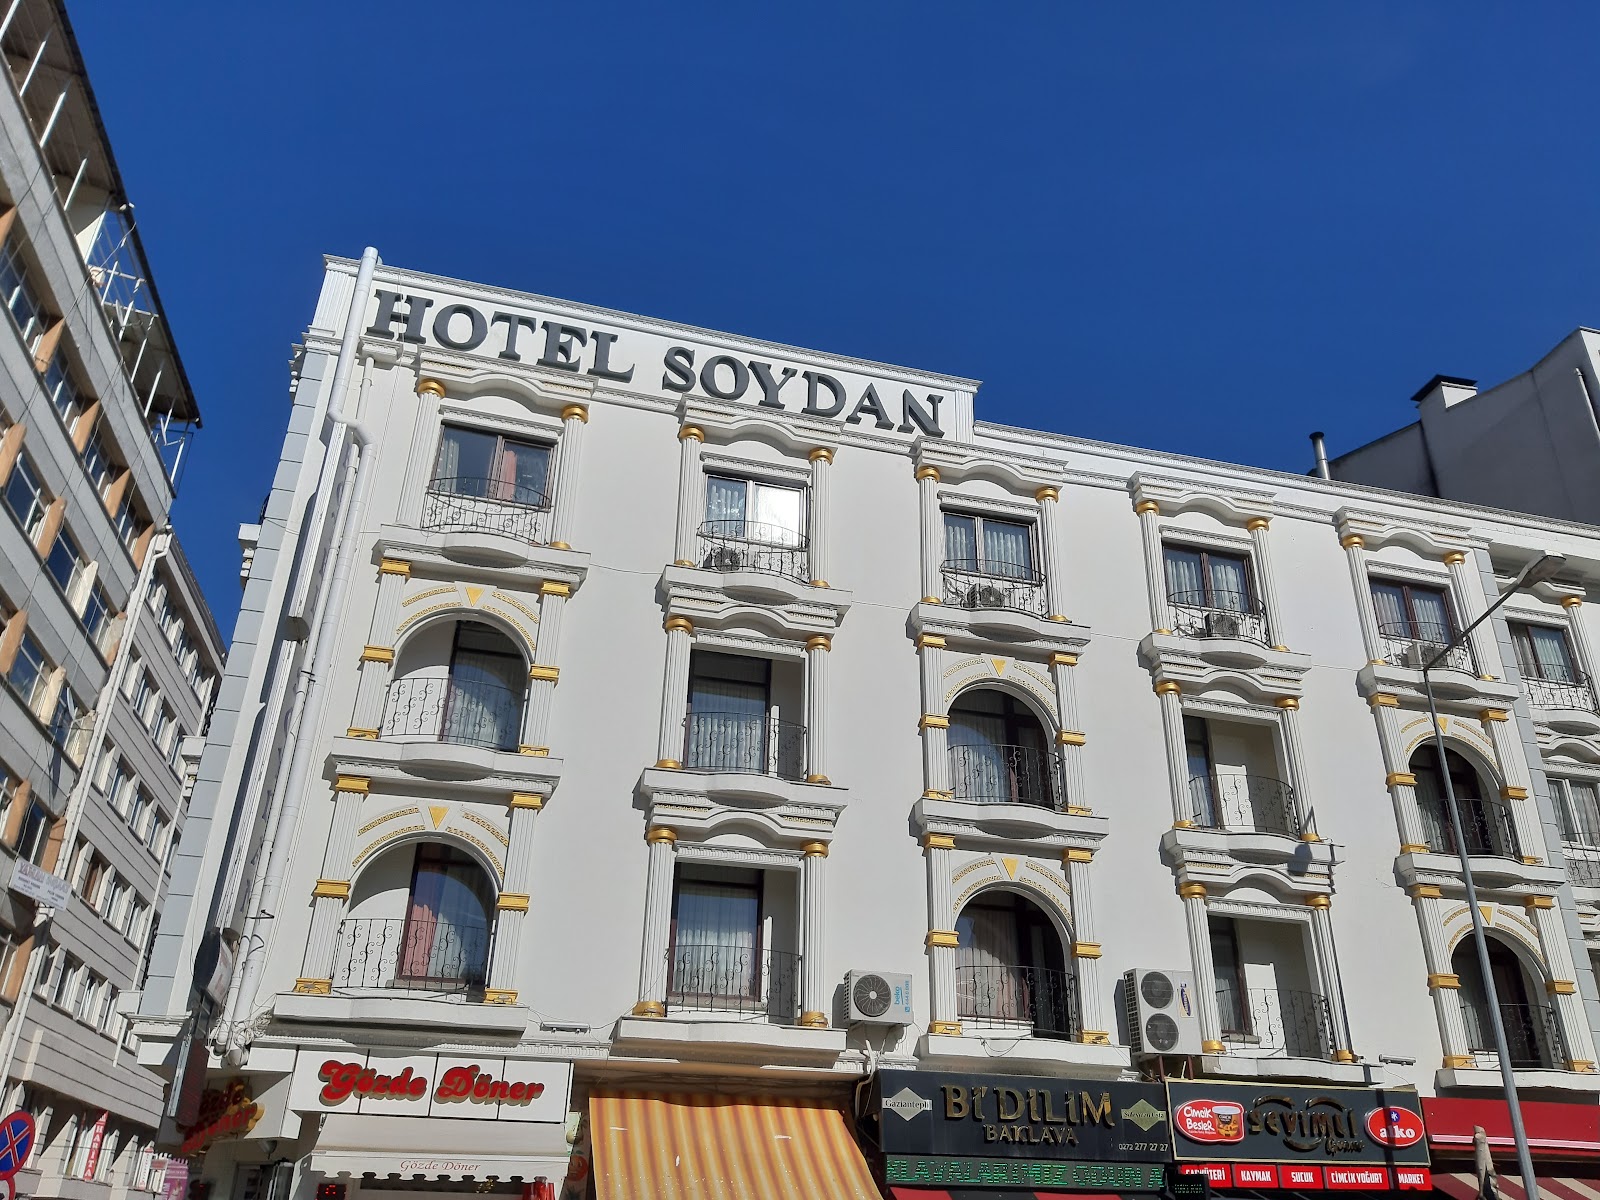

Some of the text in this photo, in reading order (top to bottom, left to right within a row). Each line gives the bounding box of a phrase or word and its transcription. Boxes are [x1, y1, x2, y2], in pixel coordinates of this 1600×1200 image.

[366, 289, 946, 438] HOTEL SOYDAN
[318, 1059, 545, 1106] Gözde Döner
[983, 1124, 1080, 1147] BAKLAVA
[1379, 1125, 1416, 1139] alko
[1118, 1142, 1169, 1152] 0272 277 27 27
[400, 1159, 481, 1172] Gözde Döner
[1241, 1170, 1272, 1182] KAYMAK
[1291, 1171, 1314, 1183] SUCUK
[1398, 1173, 1425, 1185] MARKET
